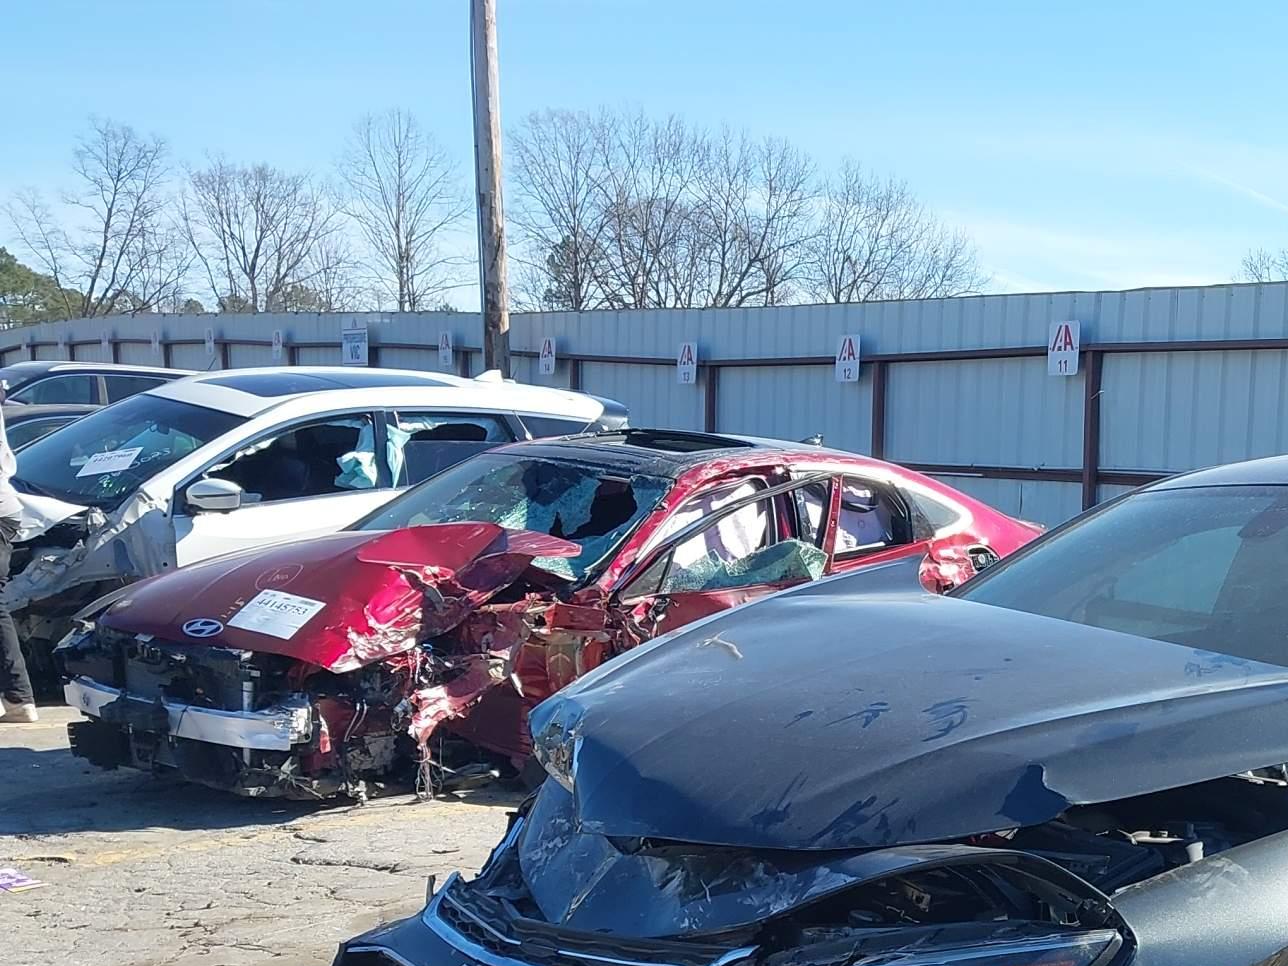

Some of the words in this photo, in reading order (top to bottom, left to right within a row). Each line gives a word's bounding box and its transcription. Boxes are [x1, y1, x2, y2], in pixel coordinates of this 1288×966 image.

[1058, 359, 1068, 373] 11
[843, 367, 852, 380] 12
[257, 598, 309, 616] 44145753
